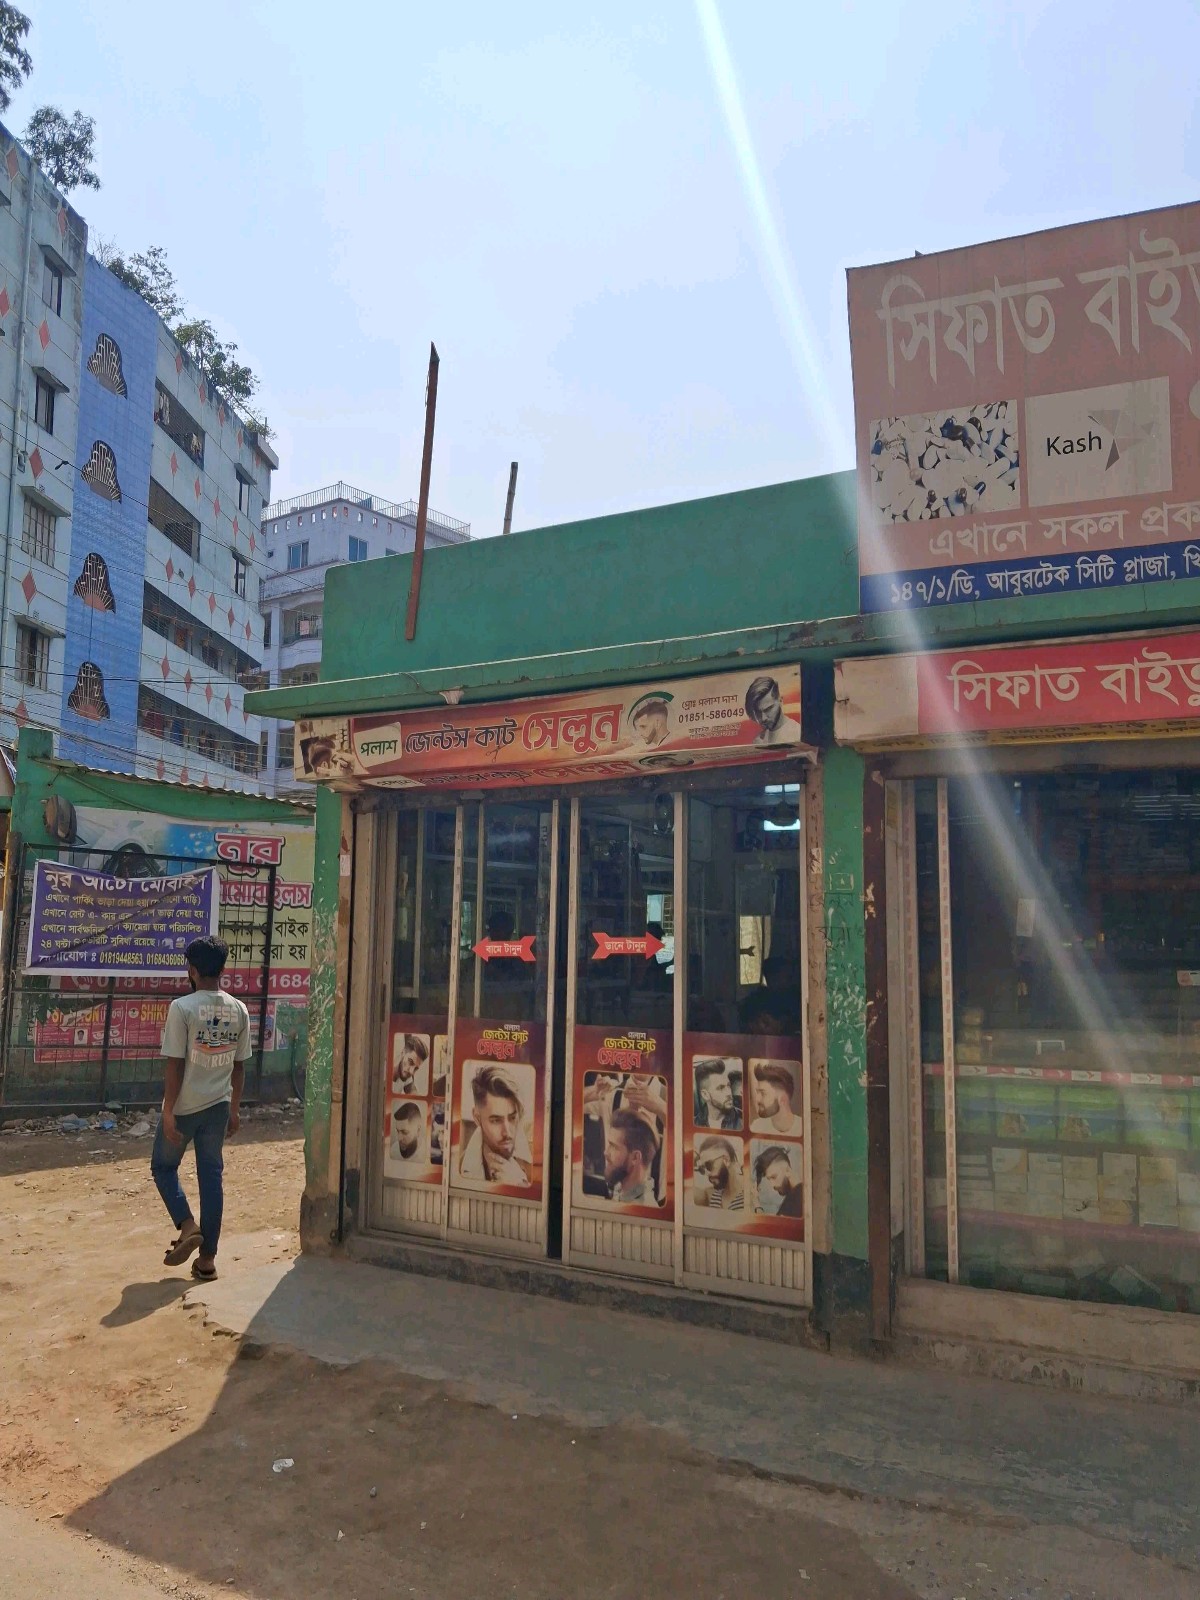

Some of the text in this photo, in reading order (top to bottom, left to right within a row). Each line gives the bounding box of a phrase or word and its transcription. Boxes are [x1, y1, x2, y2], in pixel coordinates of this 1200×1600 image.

[875, 228, 1200, 390] সিফাত বাই
[1046, 431, 1102, 457] Kash
[929, 521, 1033, 559] এখানে
[1039, 509, 1130, 546] সকল
[986, 561, 1071, 596] আবুরটেক
[1075, 555, 1117, 585] সিটি
[1123, 552, 1176, 583] প্লাজা,
[947, 659, 1086, 712] সিফাত
[678, 707, 745, 724] 01851-586049
[360, 704, 624, 757] পলাশ জেন্টস কাট সেলুন
[214, 832, 285, 877] নূর
[44, 870, 73, 893] নূর
[273, 916, 310, 938] বাইক
[289, 943, 308, 961] হয়
[503, 943, 522, 957] টানুন
[625, 938, 648, 953] টানুন
[199, 1004, 240, 1021] CHESS
